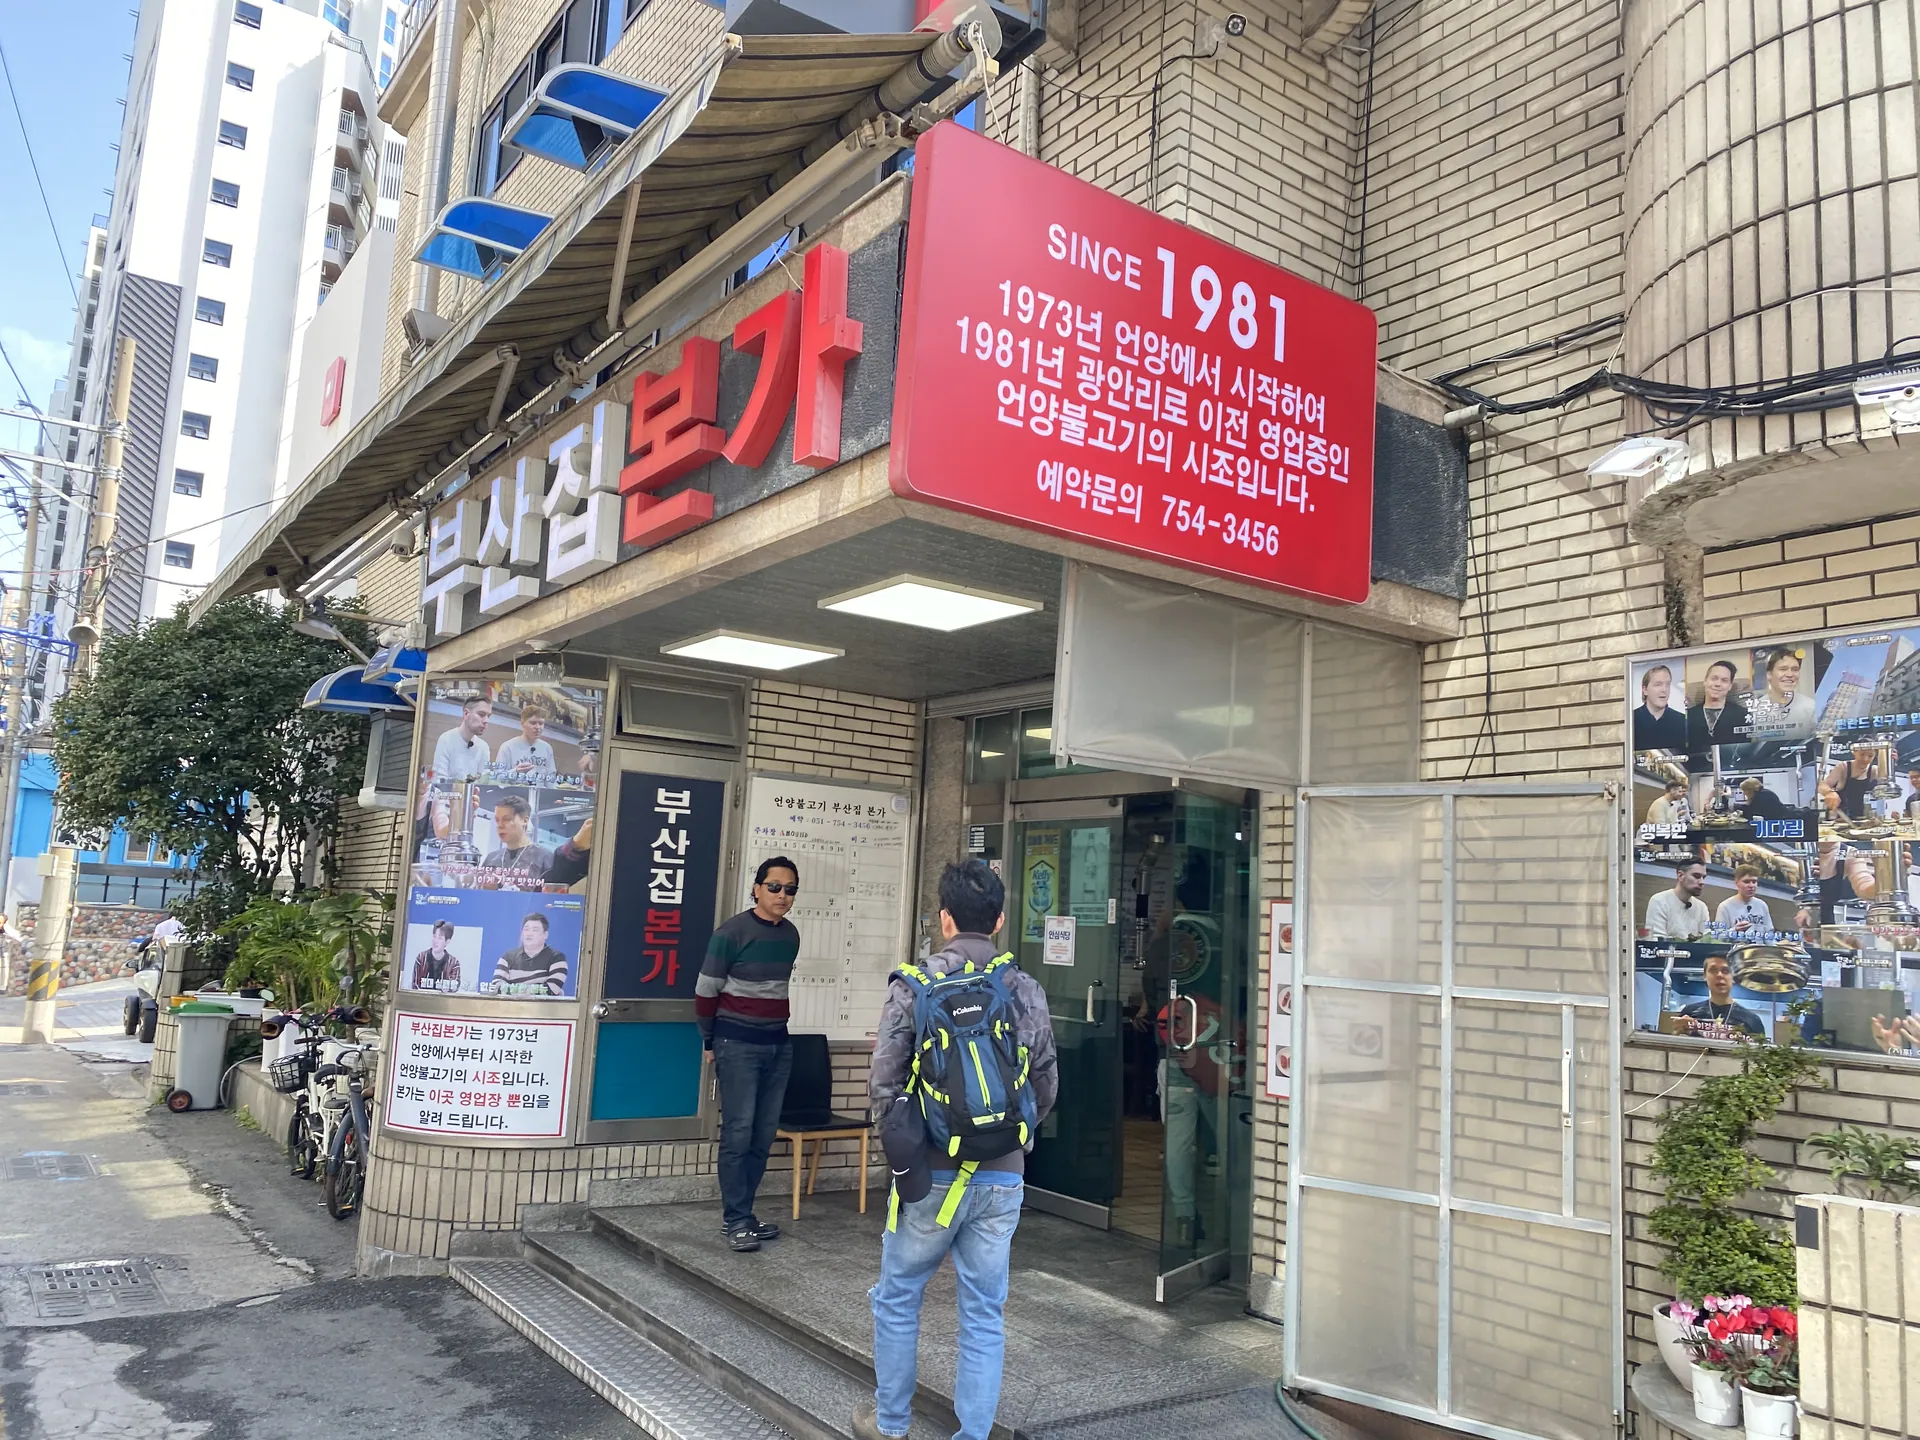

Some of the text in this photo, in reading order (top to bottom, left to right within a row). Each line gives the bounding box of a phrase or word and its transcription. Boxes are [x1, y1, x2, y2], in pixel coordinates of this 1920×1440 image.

[1047, 223, 1286, 363] SINCE 1981
[998, 279, 1326, 433] 1973년 언양에서 시작하여
[956, 315, 1350, 484] 1981년 광안리로 이전 영업중인
[996, 379, 1316, 514] 언양불고기의 시조입니다.
[1036, 459, 1280, 556] 예약문의 754-3456
[774, 796, 887, 818] 언양불고기 부산집 본가
[832, 818, 846, 828] 754
[853, 820, 871, 830] 3456
[1640, 819, 1804, 840] 행복한 기다림
[640, 787, 692, 987] 부산집본가
[1048, 929, 1071, 941] 안심식당
[956, 1004, 982, 1015] Columbia
[410, 1021, 539, 1043] 부산집본가는 1973년
[411, 1042, 533, 1065] 언양에서부터 시작한
[399, 1062, 549, 1086] 언양불고기의 시조입니다.
[396, 1084, 550, 1109] 본가는 이곳 영업장 뿐임을
[419, 1109, 509, 1130] 알려 드립니다.
